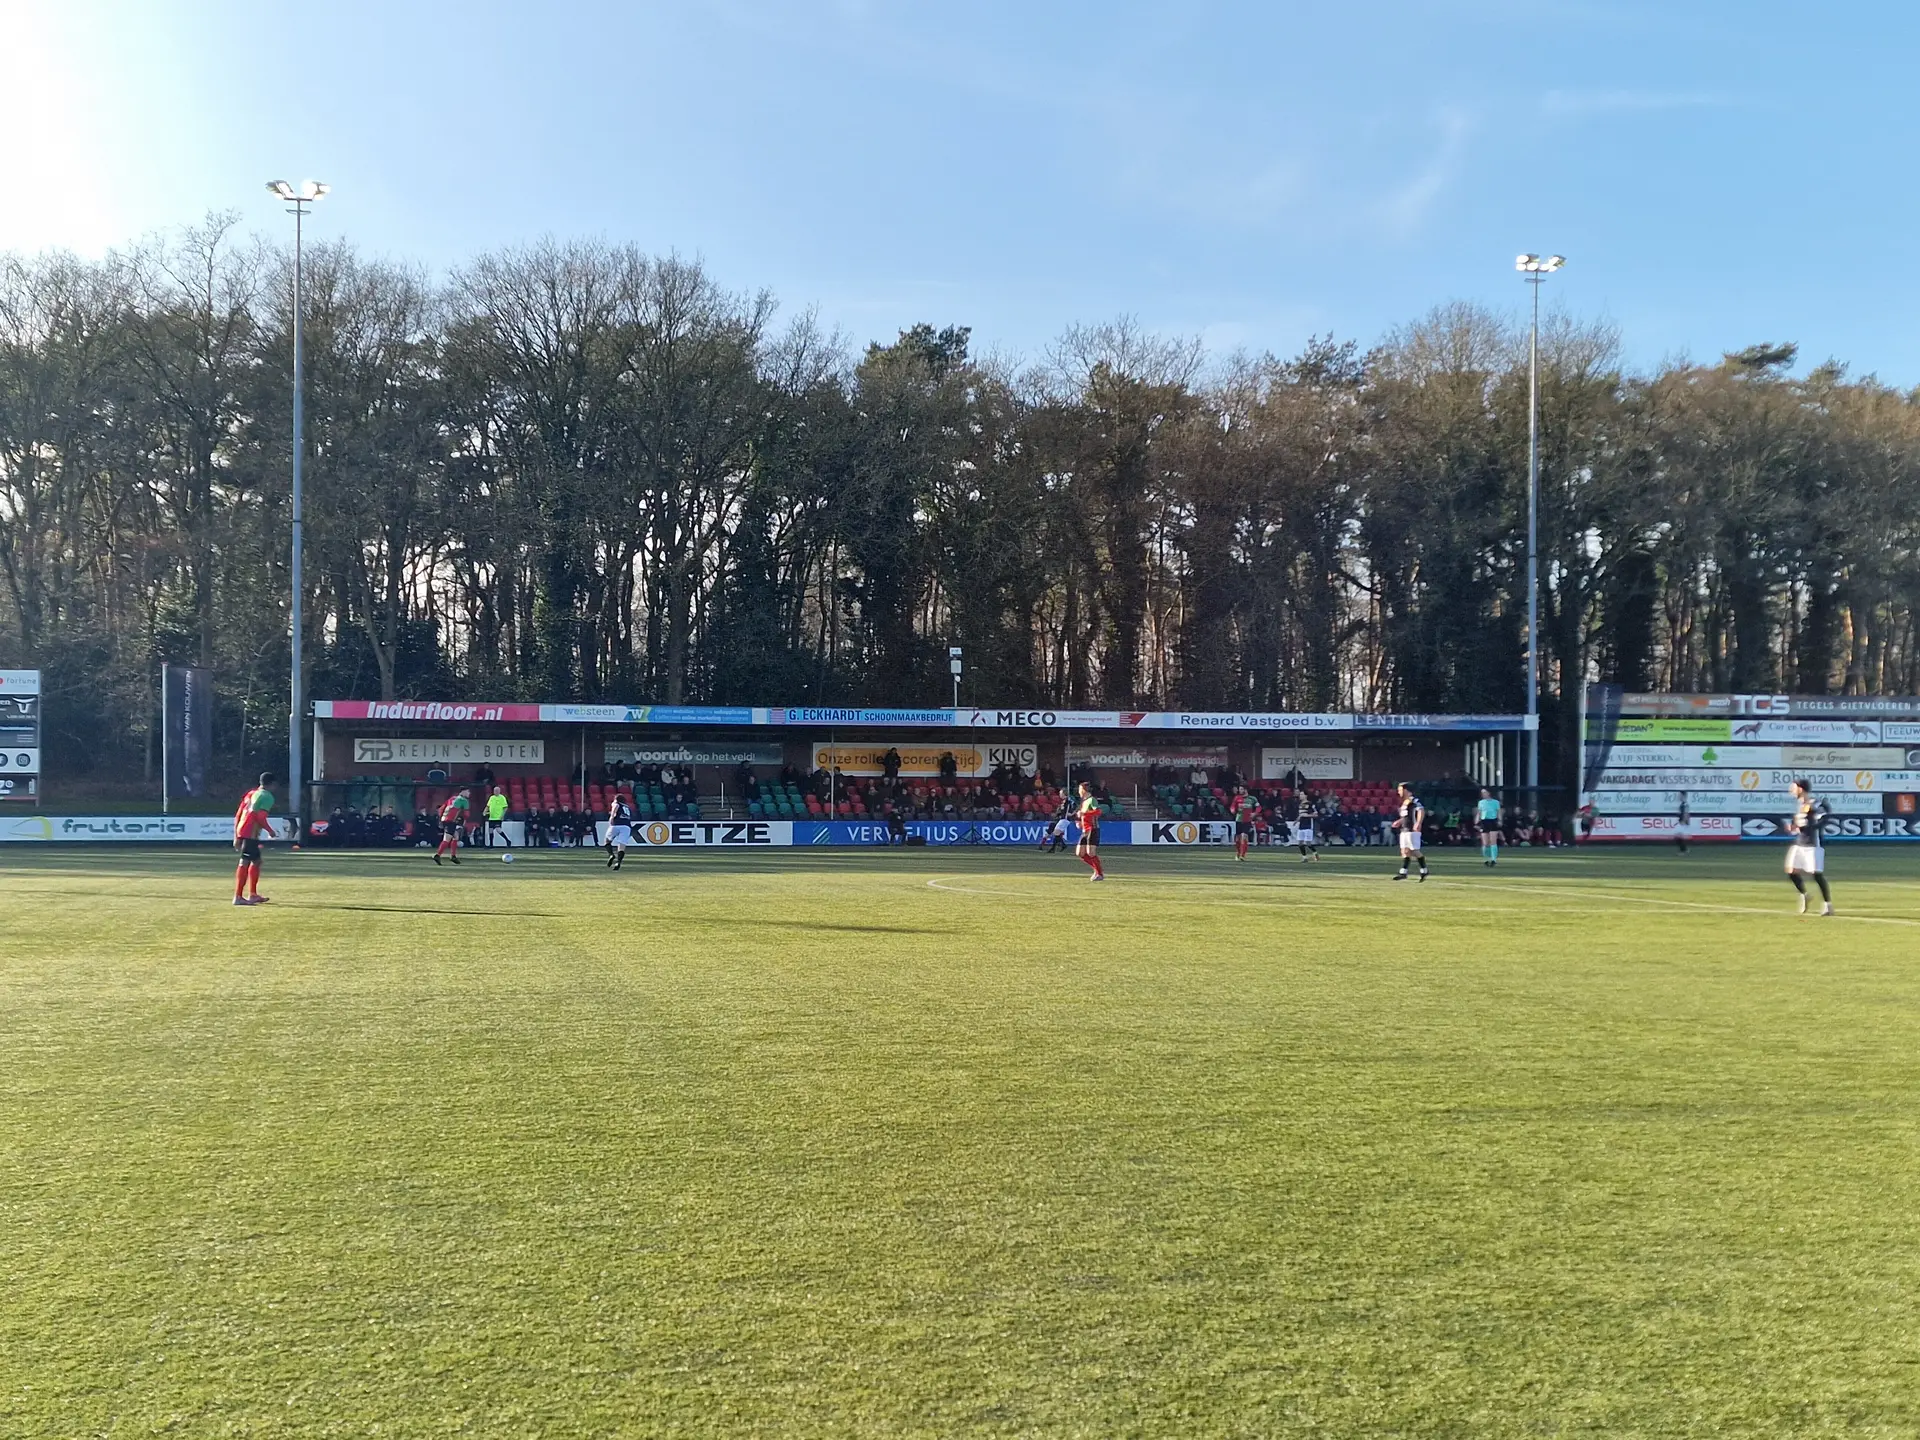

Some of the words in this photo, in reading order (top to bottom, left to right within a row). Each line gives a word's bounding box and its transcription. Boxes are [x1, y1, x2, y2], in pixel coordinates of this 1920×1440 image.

[563, 707, 615, 717] websteen
[1734, 695, 1790, 715] TCS
[1797, 701, 1834, 710] TEGELS
[1841, 701, 1911, 711] GIETVLOEREN
[789, 710, 799, 721] G.
[803, 709, 861, 721] ECKHARDT
[864, 712, 953, 723] SCHOONMAAKBEDRIJF
[996, 711, 1057, 726] MECO
[1180, 715, 1234, 726] Renard
[1240, 715, 1309, 728] Vastgoed
[1314, 716, 1338, 726] b.v.
[1355, 714, 1430, 726] LENTINK
[399, 744, 471, 758] REIJN'S
[484, 745, 539, 758] BOTEN
[633, 746, 693, 762] vooruit
[695, 753, 708, 763] op
[711, 752, 730, 762] het
[731, 752, 756, 762] veld!
[989, 748, 1034, 767] KING
[1091, 749, 1145, 765] vooruit
[818, 752, 847, 765] Onze
[854, 752, 885, 764] rolle
[901, 754, 941, 765] coren
[1601, 774, 1656, 785] VAKGARAGE
[1659, 774, 1697, 785] VISSER'S
[1701, 774, 1733, 785] AUTO'S
[1772, 770, 1844, 785] Robinzon
[62, 818, 186, 833] frutoria
